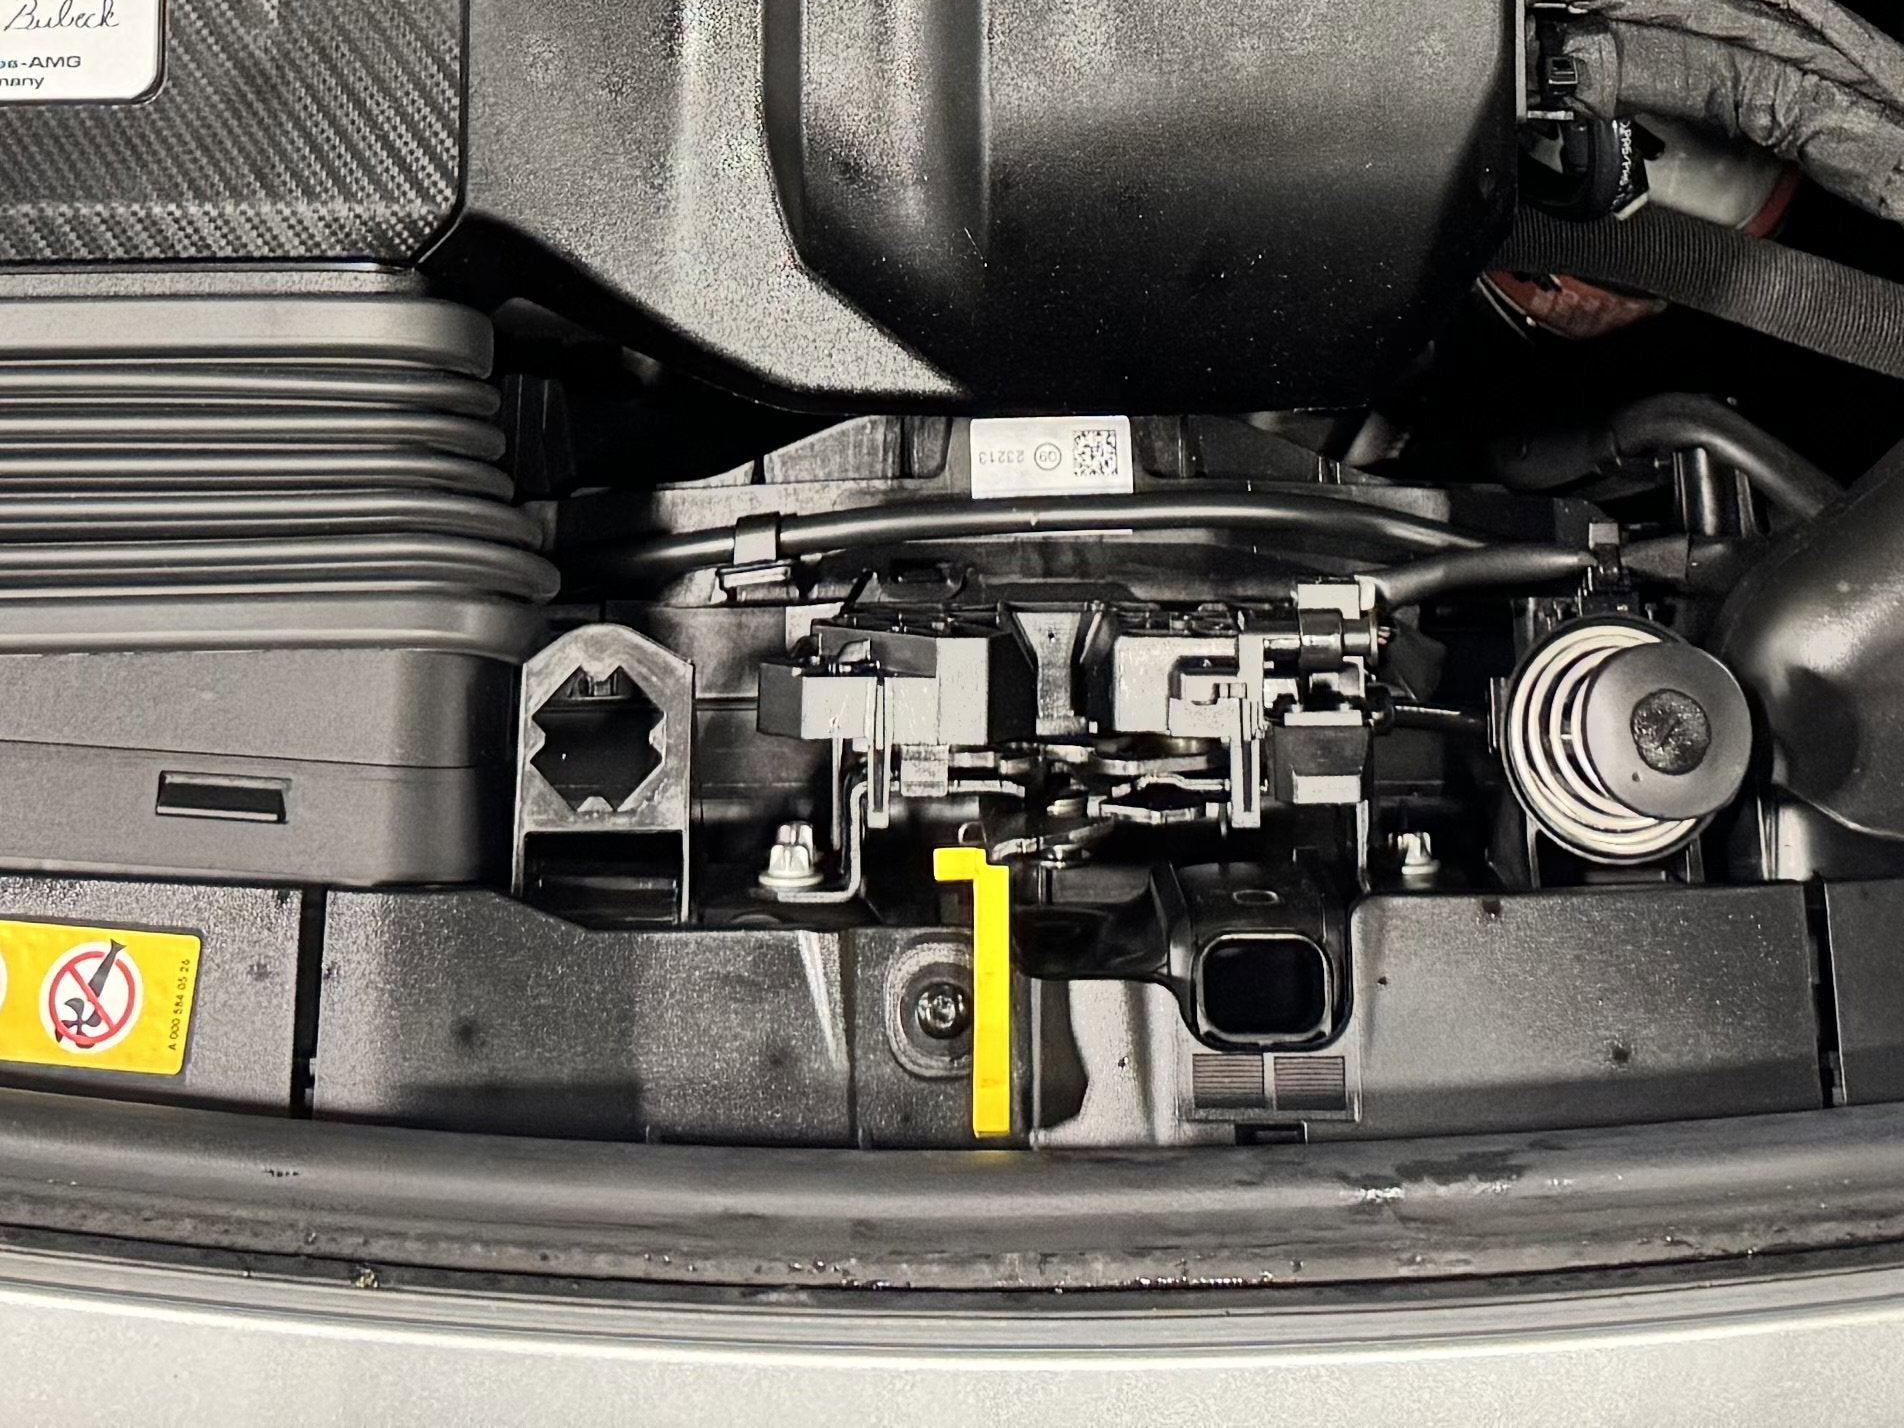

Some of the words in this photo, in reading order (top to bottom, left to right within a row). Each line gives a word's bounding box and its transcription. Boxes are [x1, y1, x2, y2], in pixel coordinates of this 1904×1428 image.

[978, 449, 1025, 465] 23213
[173, 994, 185, 1015] 584
[169, 1017, 181, 1040] 000
[168, 1043, 177, 1051] A
